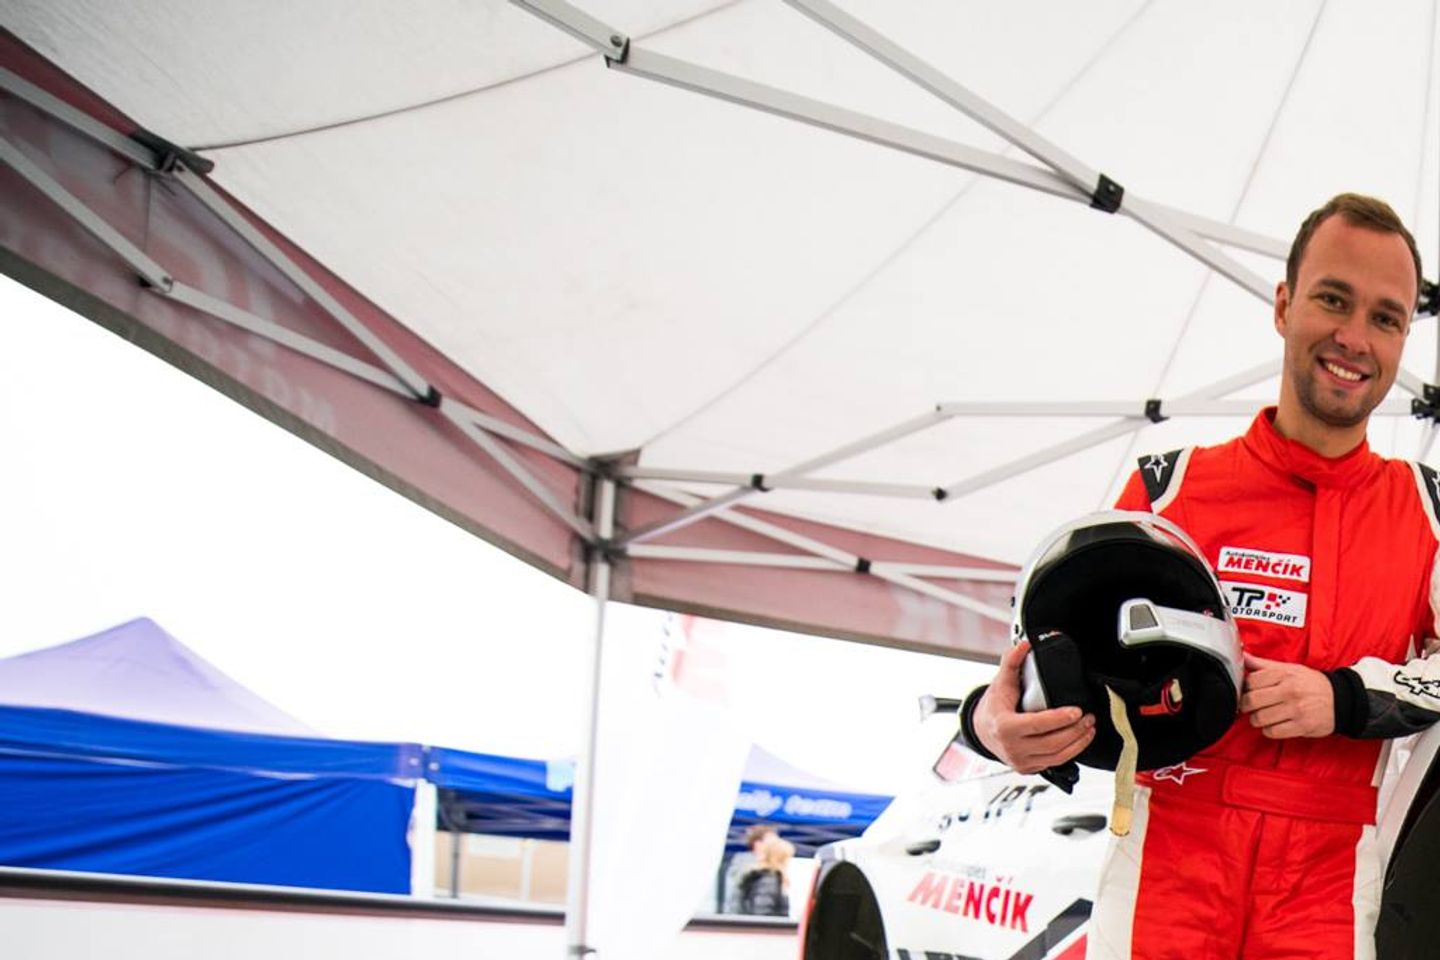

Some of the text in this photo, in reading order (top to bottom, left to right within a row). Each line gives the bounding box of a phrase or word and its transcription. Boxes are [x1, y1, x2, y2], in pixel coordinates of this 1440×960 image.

[1232, 587, 1265, 607] TP
[1231, 607, 1298, 624] OTORSPORT
[907, 871, 1034, 934] MENČÍK
